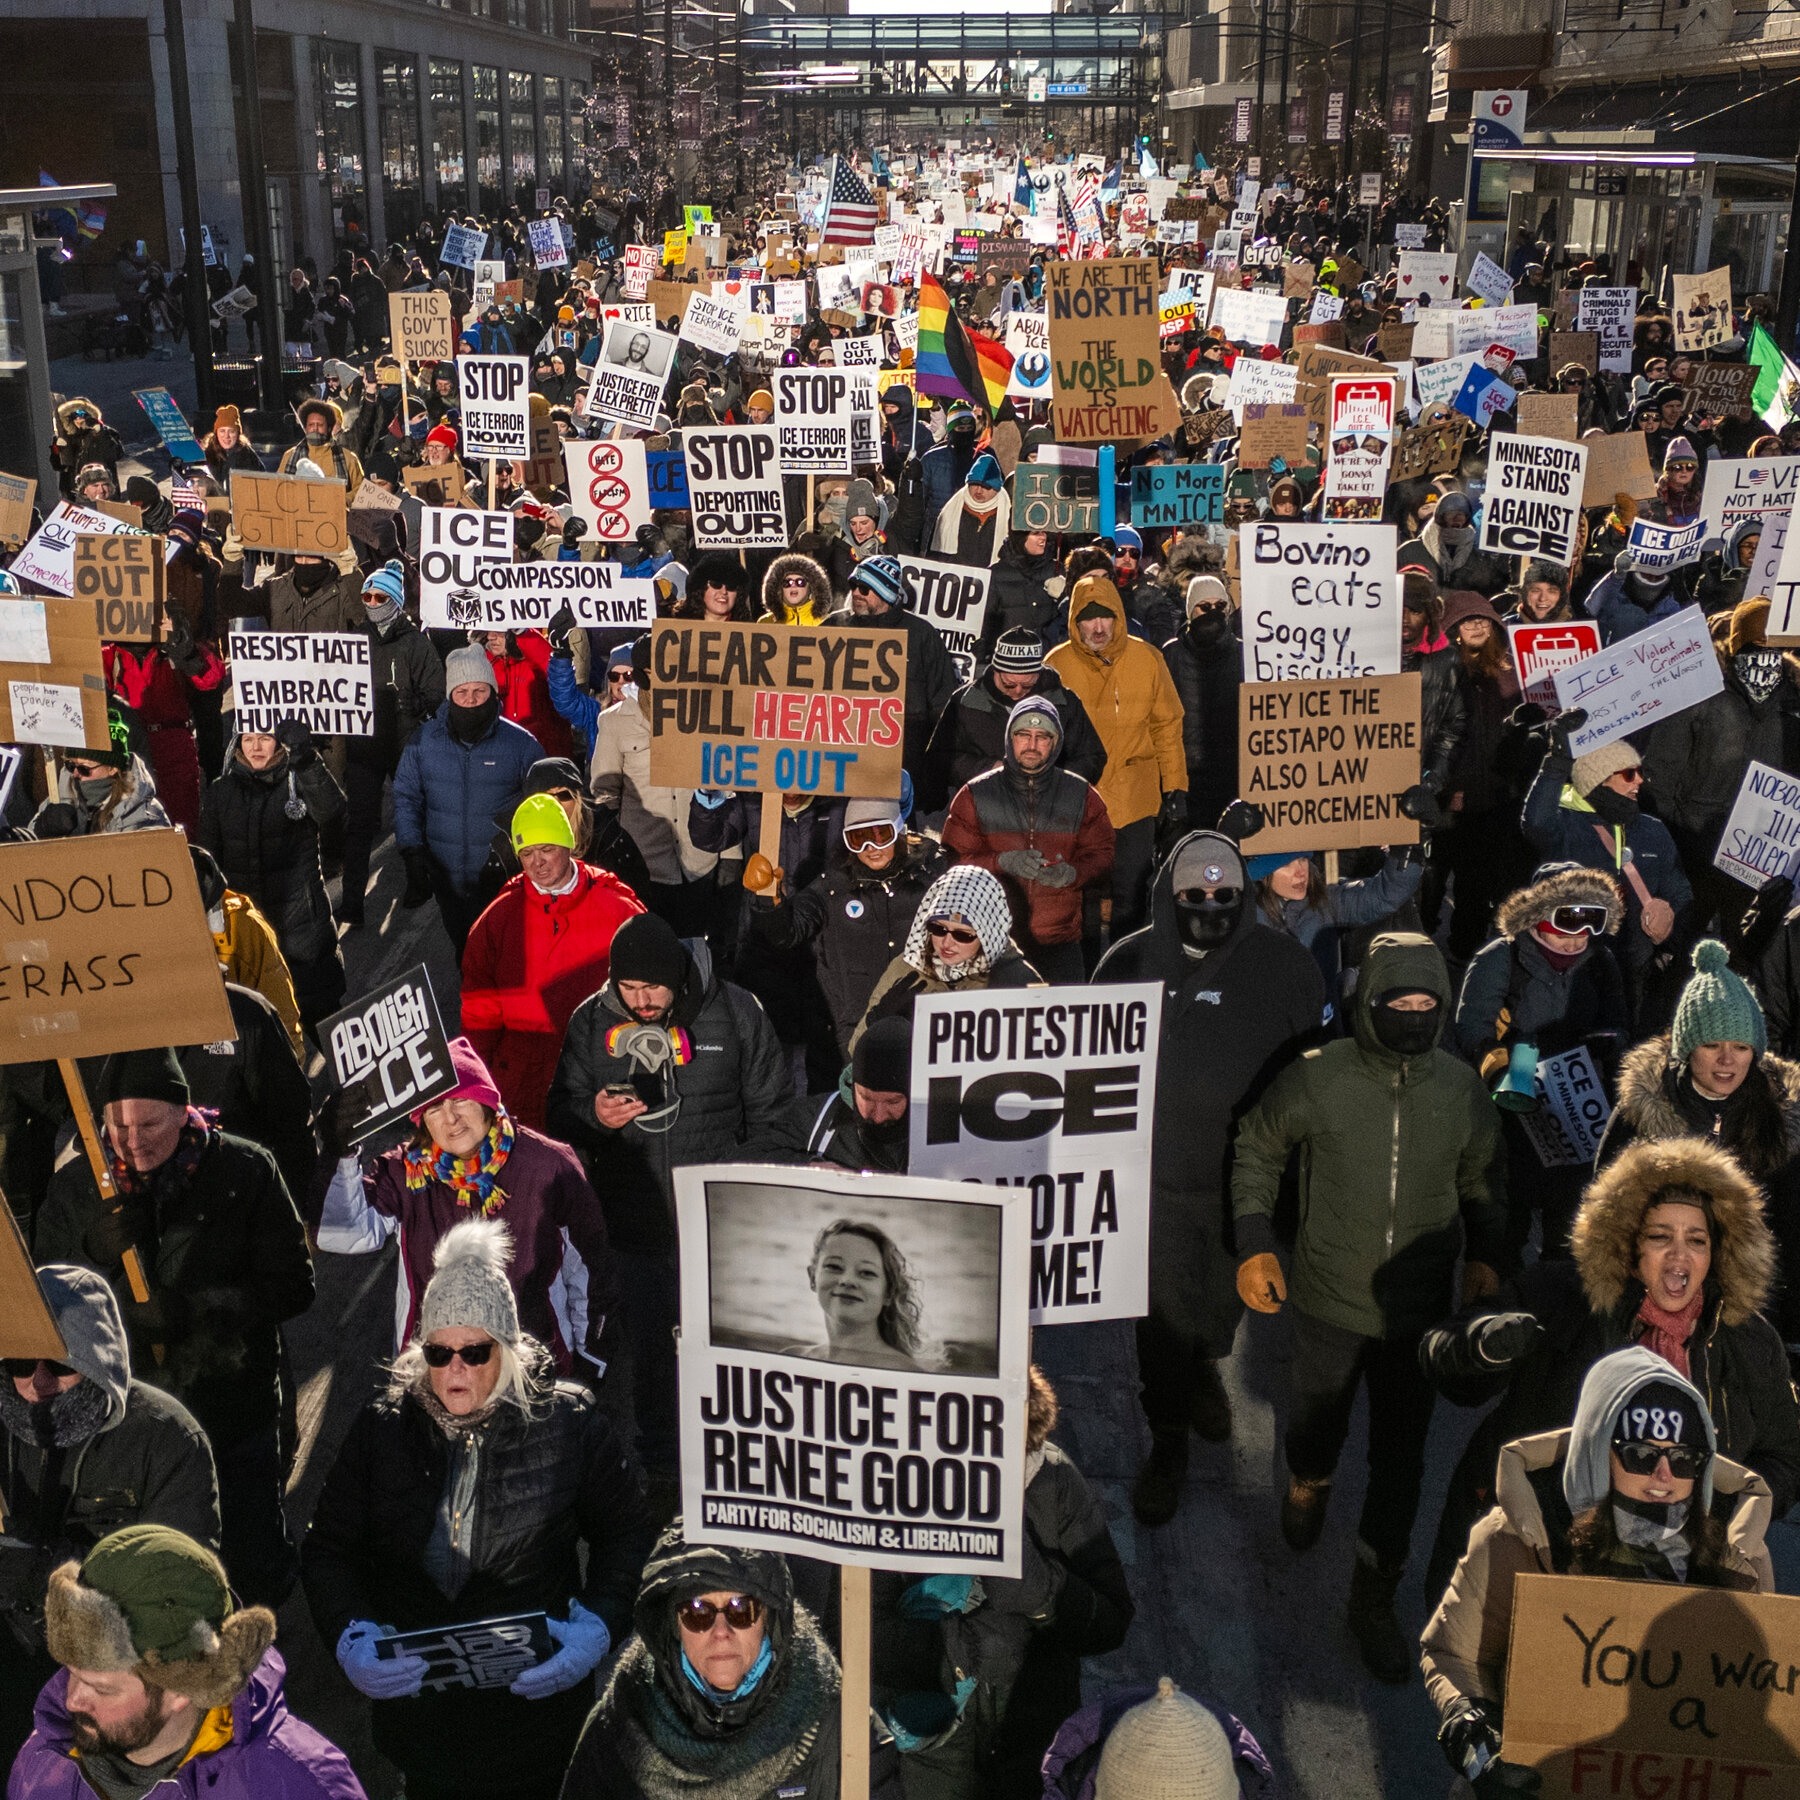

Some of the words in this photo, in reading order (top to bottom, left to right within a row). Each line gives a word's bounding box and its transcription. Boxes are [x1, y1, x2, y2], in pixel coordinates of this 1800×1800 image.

[1326, 92, 1343, 139] BOLDER
[596, 236, 609, 248] ICE
[600, 245, 615, 260] OUT
[902, 233, 928, 249] HOT
[537, 250, 565, 264] STOP!
[627, 249, 640, 264] NO
[641, 252, 657, 266] ICE
[848, 249, 874, 260] HATE
[1245, 247, 1281, 263] GTFO
[632, 270, 649, 280] ANY
[1051, 267, 1071, 287] WE
[1081, 266, 1113, 286] ARE
[1119, 263, 1152, 285] THE
[1180, 272, 1204, 297] ICE
[401, 297, 438, 315] THIS
[1054, 286, 1153, 319] NORTH
[1317, 294, 1338, 307] ICE
[1582, 299, 1630, 308] CRIMINALS
[1583, 290, 1600, 298] THE
[1606, 289, 1630, 298] ONLY
[625, 306, 651, 322] RICE
[693, 298, 718, 314] STOP
[718, 307, 737, 324] ICE
[1164, 302, 1194, 319] OUT
[1317, 307, 1337, 319] OUT
[1589, 308, 1619, 316] THUGS
[402, 317, 447, 336] GOV'T
[689, 310, 723, 333] TERROR
[723, 324, 741, 338] NOW
[404, 339, 448, 358] SUCKS
[764, 338, 785, 350] Don
[843, 349, 873, 358] OUT
[845, 340, 869, 349] ICE
[1025, 336, 1049, 350] ICE
[1081, 340, 1117, 360] THE
[1056, 359, 1155, 390] WORLD
[1238, 359, 1261, 375] The
[1451, 361, 1463, 371] my
[1691, 364, 1745, 386] Love
[464, 361, 523, 402] STOP
[596, 372, 639, 394] JUSTICE
[639, 381, 660, 400] FOR
[1241, 385, 1257, 395] lies
[1261, 388, 1274, 396] in
[1252, 376, 1269, 387] the
[1708, 383, 1738, 402] Thy
[593, 387, 622, 408] ALEX
[621, 393, 656, 417] PRETTI
[780, 375, 845, 414] STOP
[1086, 389, 1117, 408] IS
[1487, 388, 1508, 409] ICE
[465, 411, 481, 428] ICE
[482, 411, 525, 431] TERROR
[1059, 405, 1158, 438] WATCHING
[467, 431, 525, 444] NOW!
[780, 427, 798, 445] ICE
[800, 427, 846, 445] TERROR
[688, 434, 775, 481] STOP
[780, 447, 846, 459] NOW!
[1363, 457, 1383, 465] NOT
[1496, 441, 1581, 473] MINNESOTA
[1025, 473, 1094, 500] ICE
[1137, 470, 1164, 492] No
[1176, 469, 1221, 488] More
[1341, 470, 1373, 479] GONNA
[1502, 464, 1571, 496] STANDS
[241, 477, 328, 514] ICE
[363, 484, 375, 494] NO
[377, 492, 396, 507] ONE
[1336, 483, 1359, 492] TAKE
[1362, 483, 1375, 492] IT!
[693, 490, 781, 513] DEPORTING
[1724, 493, 1757, 508] NOT
[60, 501, 106, 533] Trump's
[605, 515, 620, 526] ICE
[696, 513, 783, 536] OUR
[1025, 500, 1099, 530] OUT
[1488, 497, 1574, 535] AGAINST
[240, 515, 339, 548] GTFO
[432, 512, 507, 549] ICE
[699, 537, 753, 545] FAMILIES
[754, 536, 784, 544] NOW
[1486, 525, 1569, 561] ICE
[1642, 529, 1668, 549] ICE
[1669, 526, 1698, 548] OUT!
[77, 537, 143, 562] ICE
[1255, 524, 1371, 567] Bovino
[1677, 543, 1699, 562] ICE!
[76, 565, 150, 597] OUT
[478, 566, 612, 591] COMPASSION
[1292, 571, 1382, 609] eats
[902, 565, 984, 622] STOP
[486, 600, 505, 622] IS
[511, 597, 552, 621] NOT
[1255, 610, 1351, 663] Soggy
[232, 636, 308, 661] RESIST
[313, 639, 369, 665] HATE
[655, 629, 778, 687] CLEAR
[786, 636, 903, 693] EYES
[1568, 664, 1620, 700] ICE
[1650, 641, 1702, 674] Criminals
[13, 684, 39, 698] people
[240, 678, 368, 707] EMBRACE
[1250, 693, 1293, 721] HEY
[1300, 690, 1331, 718] ICE
[1339, 689, 1380, 715] THE
[652, 688, 745, 737] FULL
[752, 690, 904, 748] HEARTS
[1248, 725, 1345, 756] GESTAPO
[1354, 722, 1416, 750] WERE
[701, 742, 760, 788] ICE
[775, 747, 859, 793] OUT
[1249, 763, 1307, 792] ALSO
[1318, 757, 1369, 787] LAW
[928, 1001, 1147, 1065] PROTESTING
[1551, 1062, 1564, 1078] OF
[1563, 1052, 1593, 1094] ICE
[926, 1064, 1141, 1146] ICE
[1557, 1082, 1594, 1156] MINNESOTA
[1090, 1169, 1119, 1235] A
[700, 1364, 898, 1450] JUSTICE
[907, 1390, 1004, 1458] FOR
[1622, 1407, 1683, 1444] 1989
[703, 1429, 852, 1511] RENEE
[862, 1450, 1001, 1523] GOOD
[706, 1502, 758, 1527] PARTY
[760, 1507, 790, 1531] FOR
[793, 1511, 876, 1547] SOCIALISM
[879, 1527, 901, 1548] &
[902, 1530, 998, 1555] LIBERATION
[1563, 1613, 1682, 1689] You
[1669, 1697, 1719, 1739] a
[1571, 1747, 1773, 1800] FIGHT
